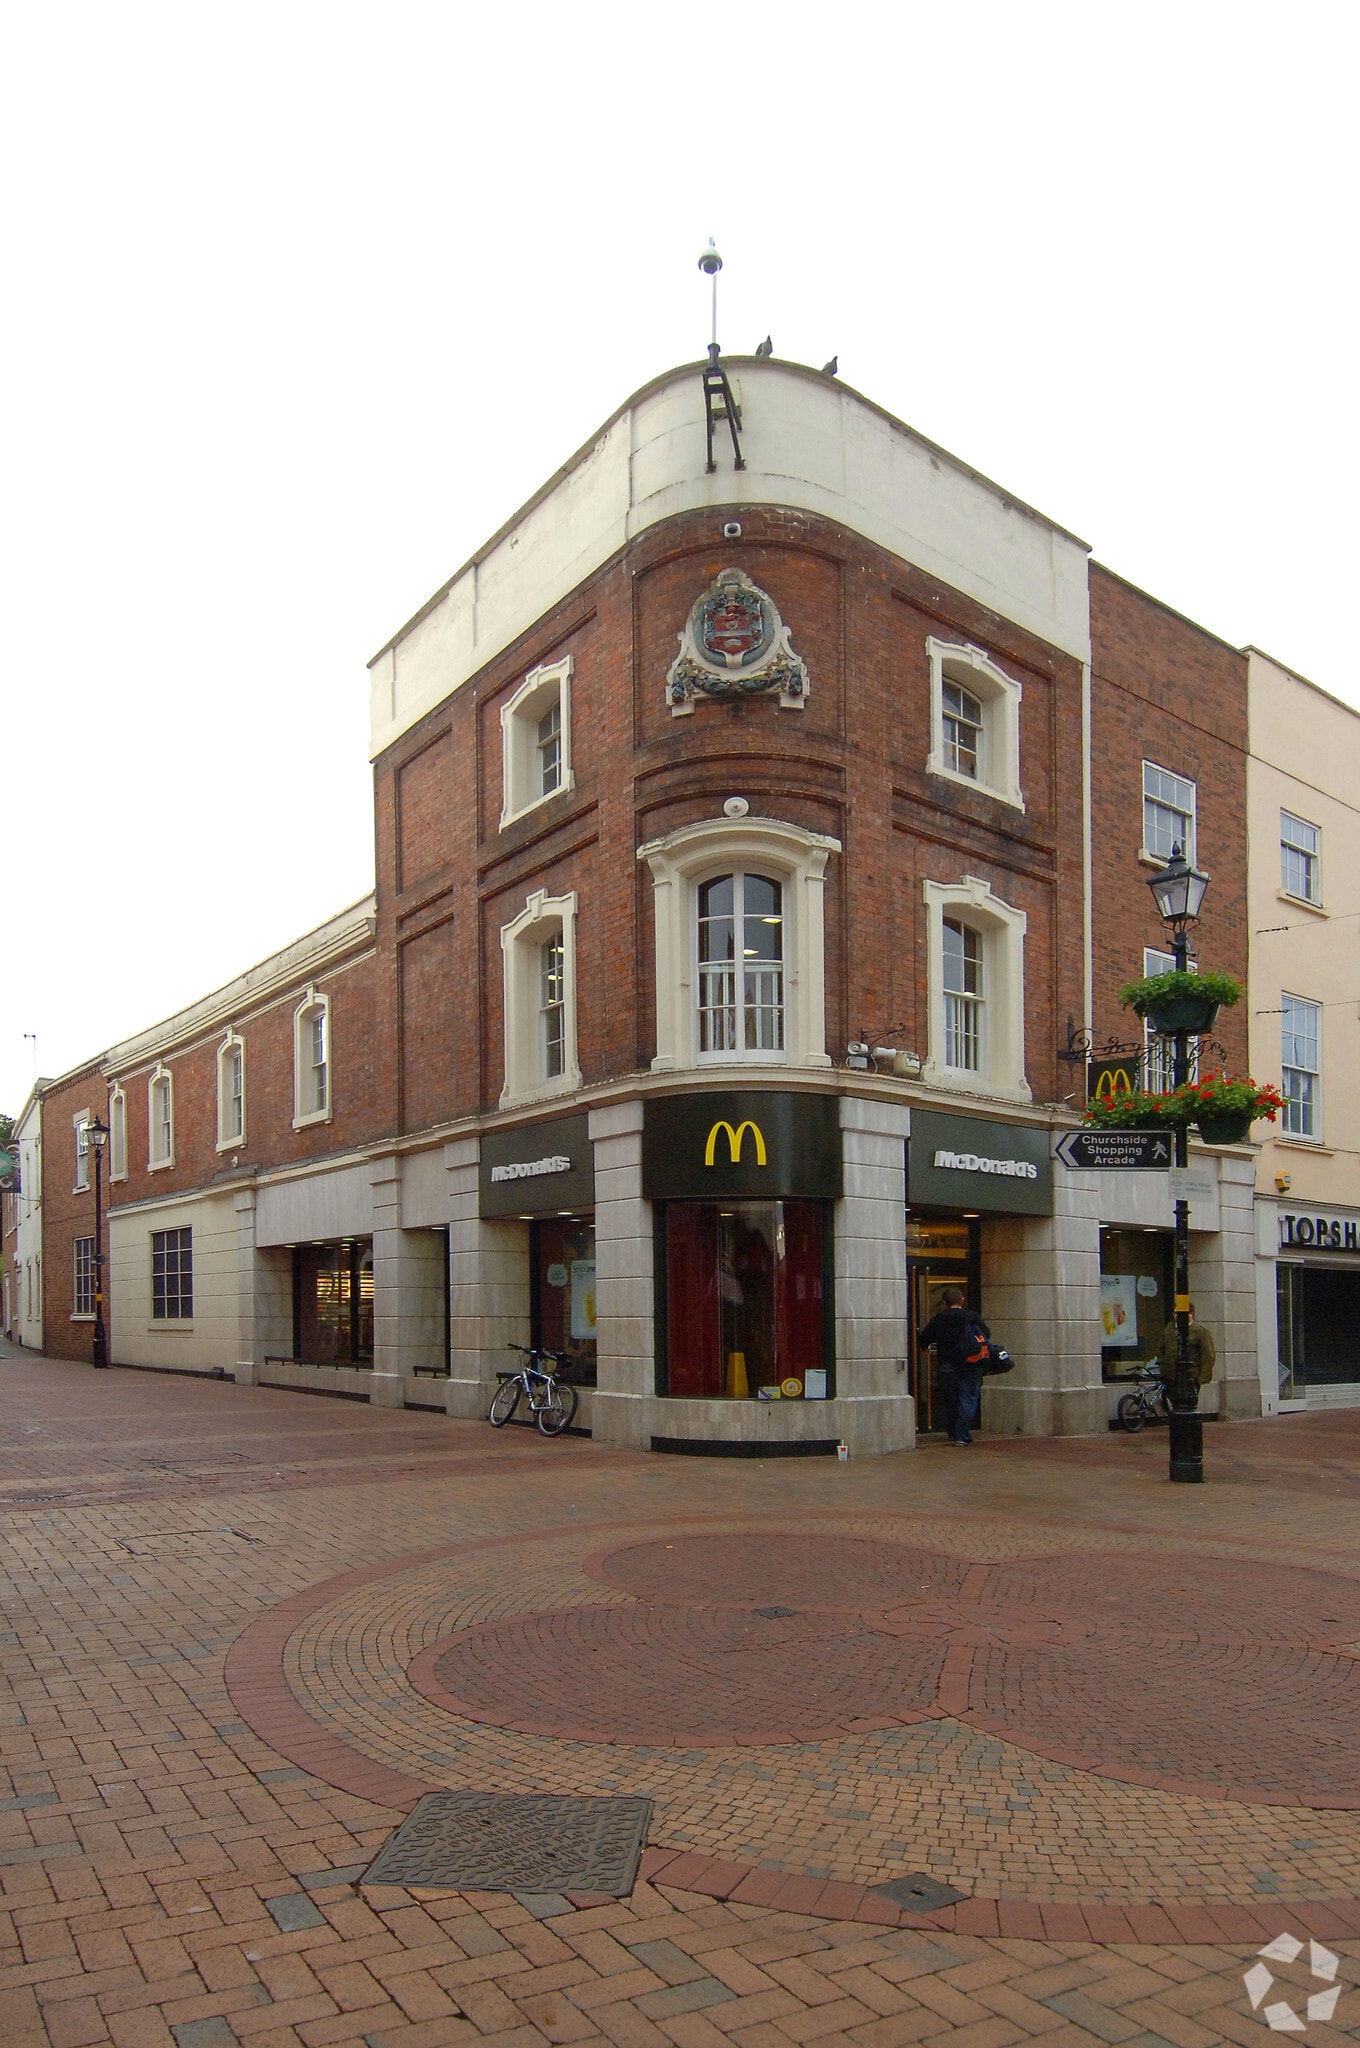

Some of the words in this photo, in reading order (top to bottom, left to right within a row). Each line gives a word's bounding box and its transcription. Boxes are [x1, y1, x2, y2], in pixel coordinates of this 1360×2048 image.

[1081, 1135, 1148, 1144] Churchside
[1087, 1145, 1143, 1156] Shopping
[934, 1150, 1038, 1179] McDonald's
[1094, 1156, 1136, 1165] Arcade
[1283, 1214, 1360, 1249] TOPSH
